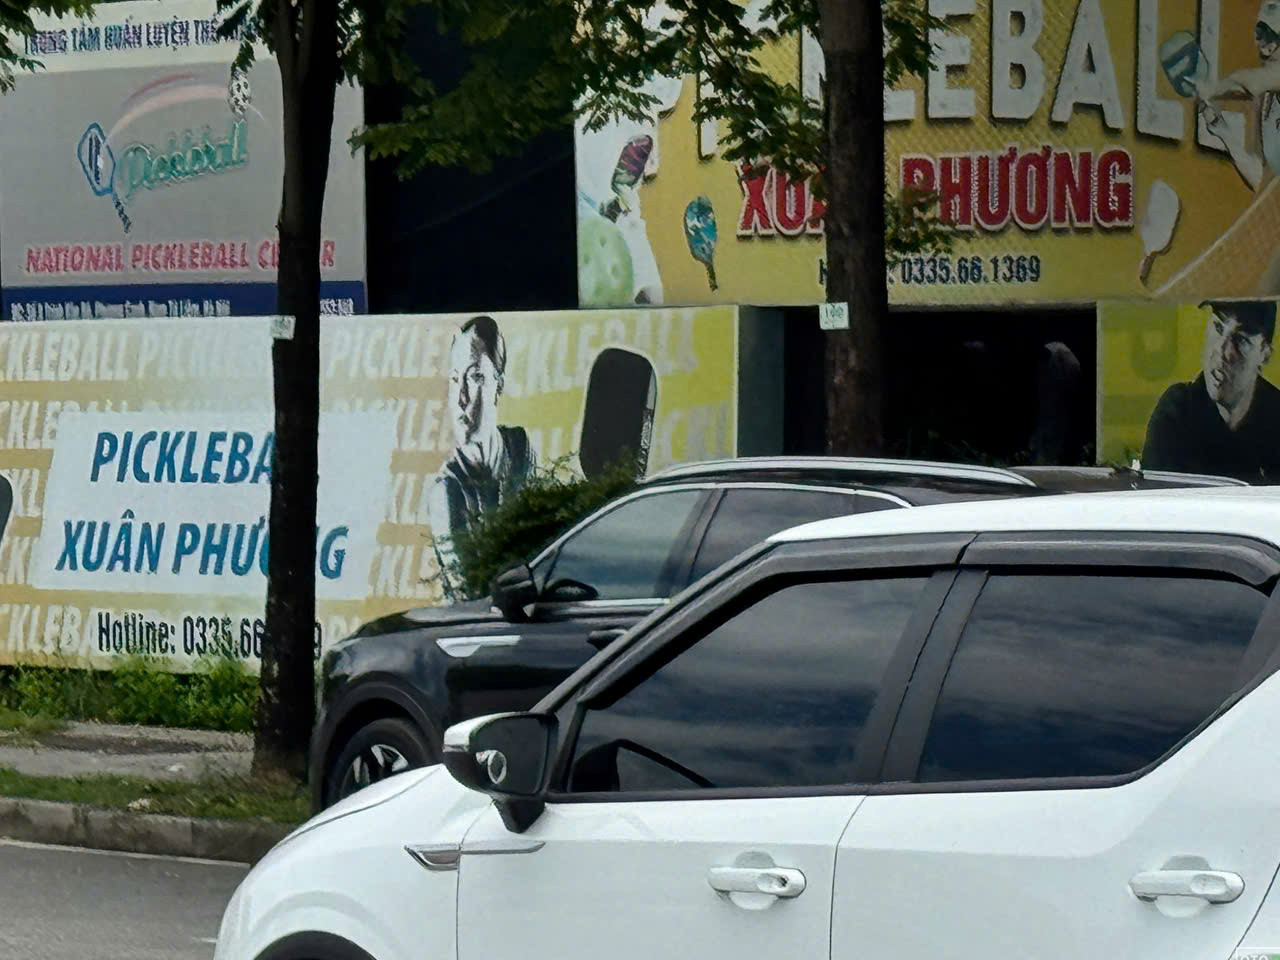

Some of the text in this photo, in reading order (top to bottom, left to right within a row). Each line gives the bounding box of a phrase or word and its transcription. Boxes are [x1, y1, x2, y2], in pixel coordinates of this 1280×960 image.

[26, 247, 124, 272] NATIONAL
[131, 242, 249, 270] PICKLEBALL
[90, 430, 278, 484] PICKLEBA
[54, 508, 166, 575] XUÂN
[171, 515, 349, 579] PHƯG
[97, 611, 176, 655] Hotline:
